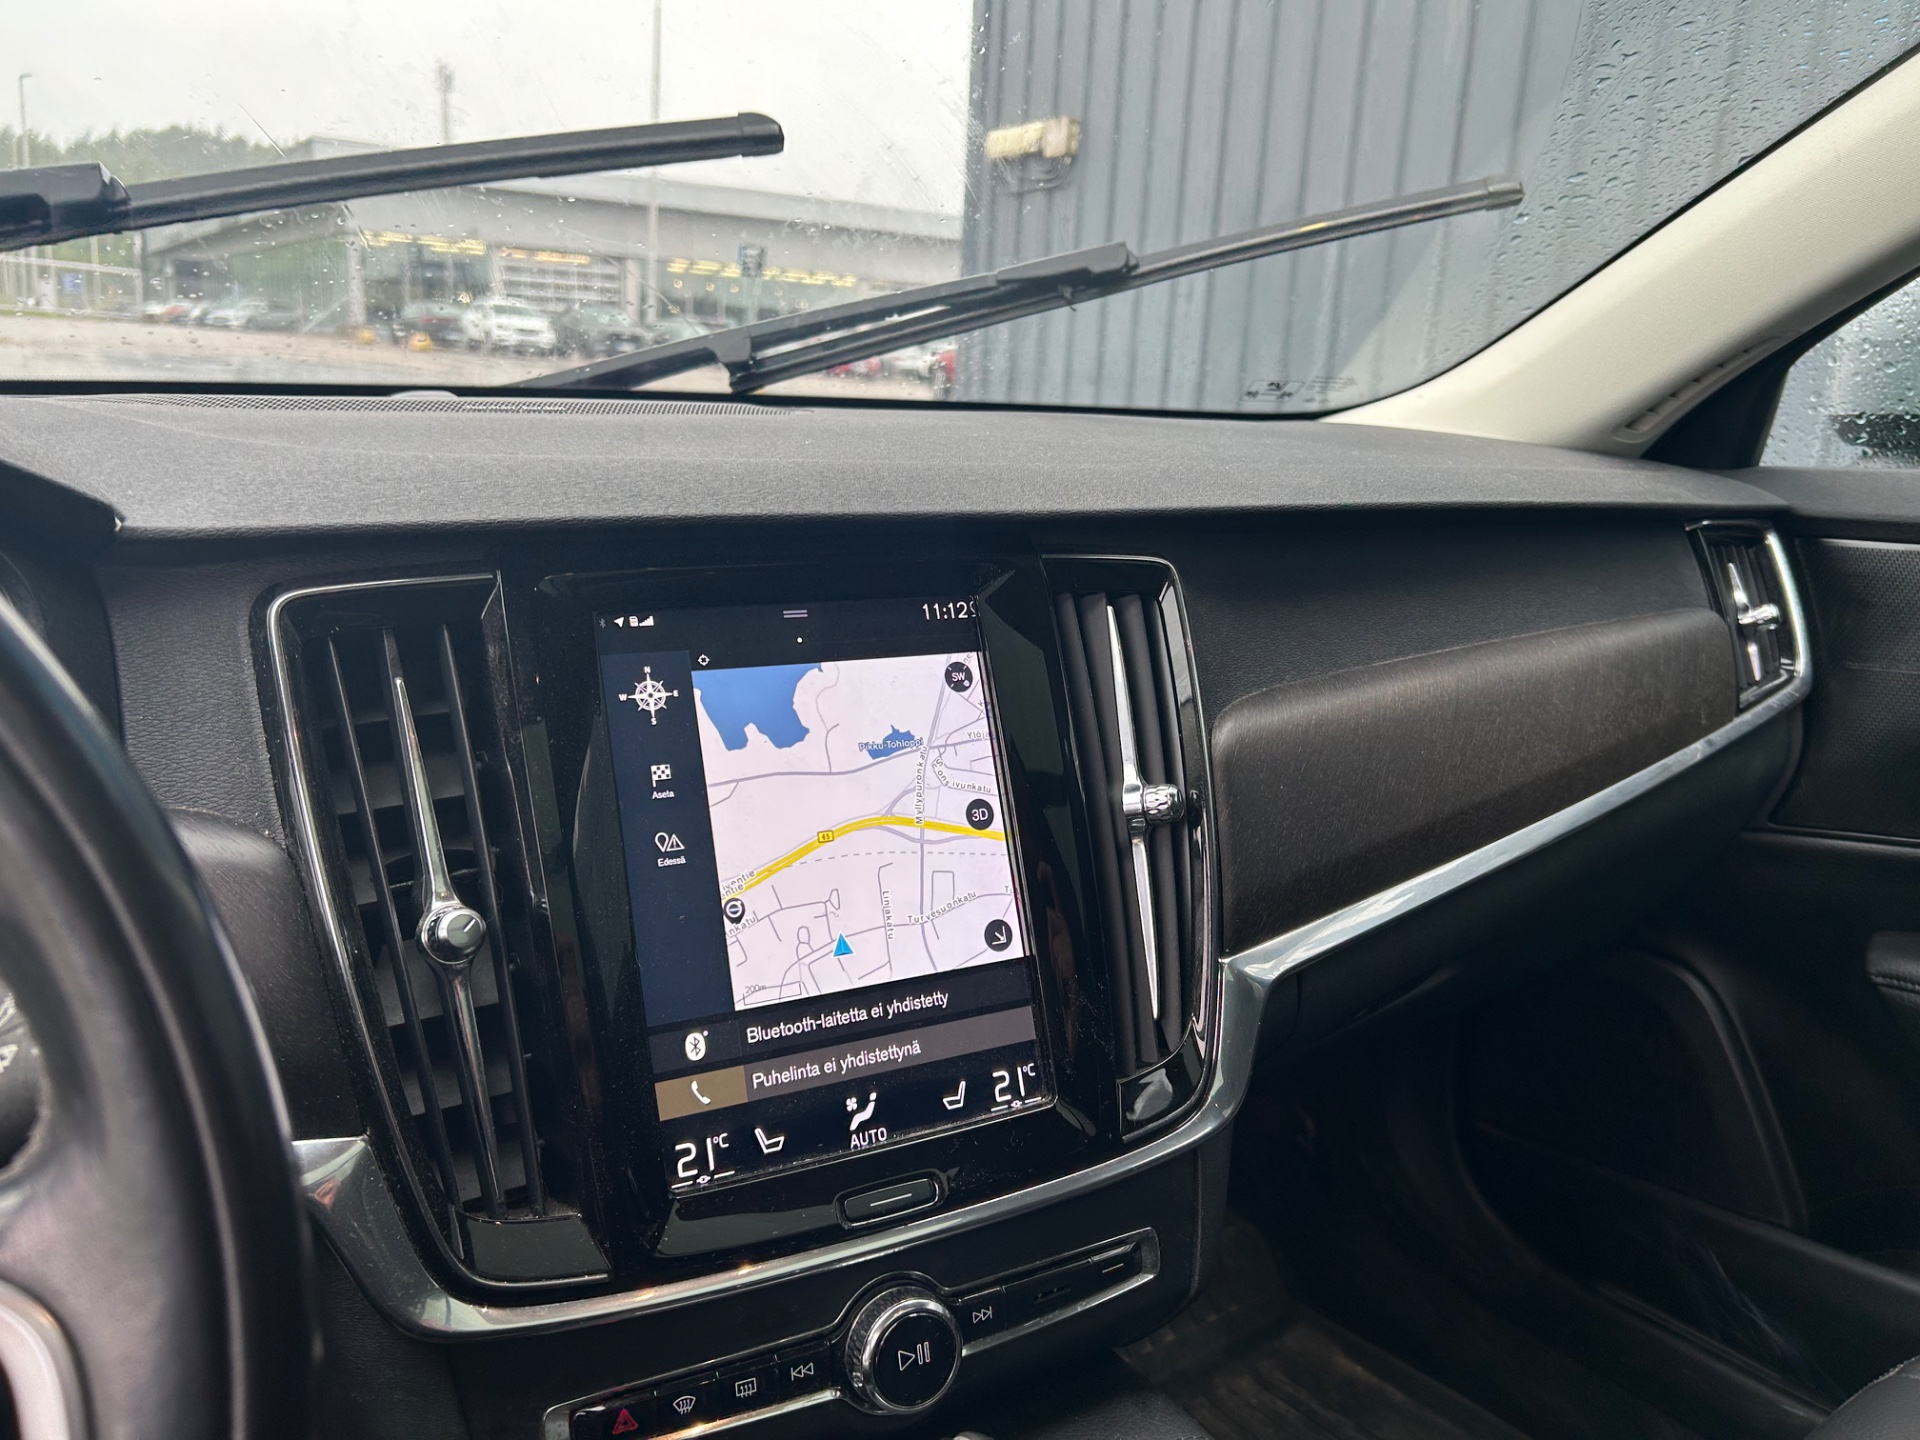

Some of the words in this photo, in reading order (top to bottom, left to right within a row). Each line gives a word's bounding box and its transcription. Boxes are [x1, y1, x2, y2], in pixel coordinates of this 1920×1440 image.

[922, 601, 968, 620] 11:12
[643, 665, 651, 673] N
[951, 672, 966, 682] SW
[619, 693, 628, 701] W
[651, 717, 657, 725] S
[858, 737, 924, 752] Pikku-Tohloppi
[915, 746, 928, 824] Myllypuronkatu
[652, 790, 675, 799] Aseta
[971, 808, 989, 822] 3D
[657, 856, 686, 867] Edessä
[908, 891, 977, 924] Turvesuonkatu
[882, 891, 894, 940] Linjakatu
[746, 1007, 868, 1044] Bluetooth-laitetta
[871, 1002, 883, 1018] ei
[887, 991, 949, 1019] yhdistetty
[752, 1062, 821, 1089] Puhelinta
[824, 1057, 836, 1073] ei
[840, 1040, 921, 1075] yhdistettynä
[850, 1127, 888, 1149] AUTO
